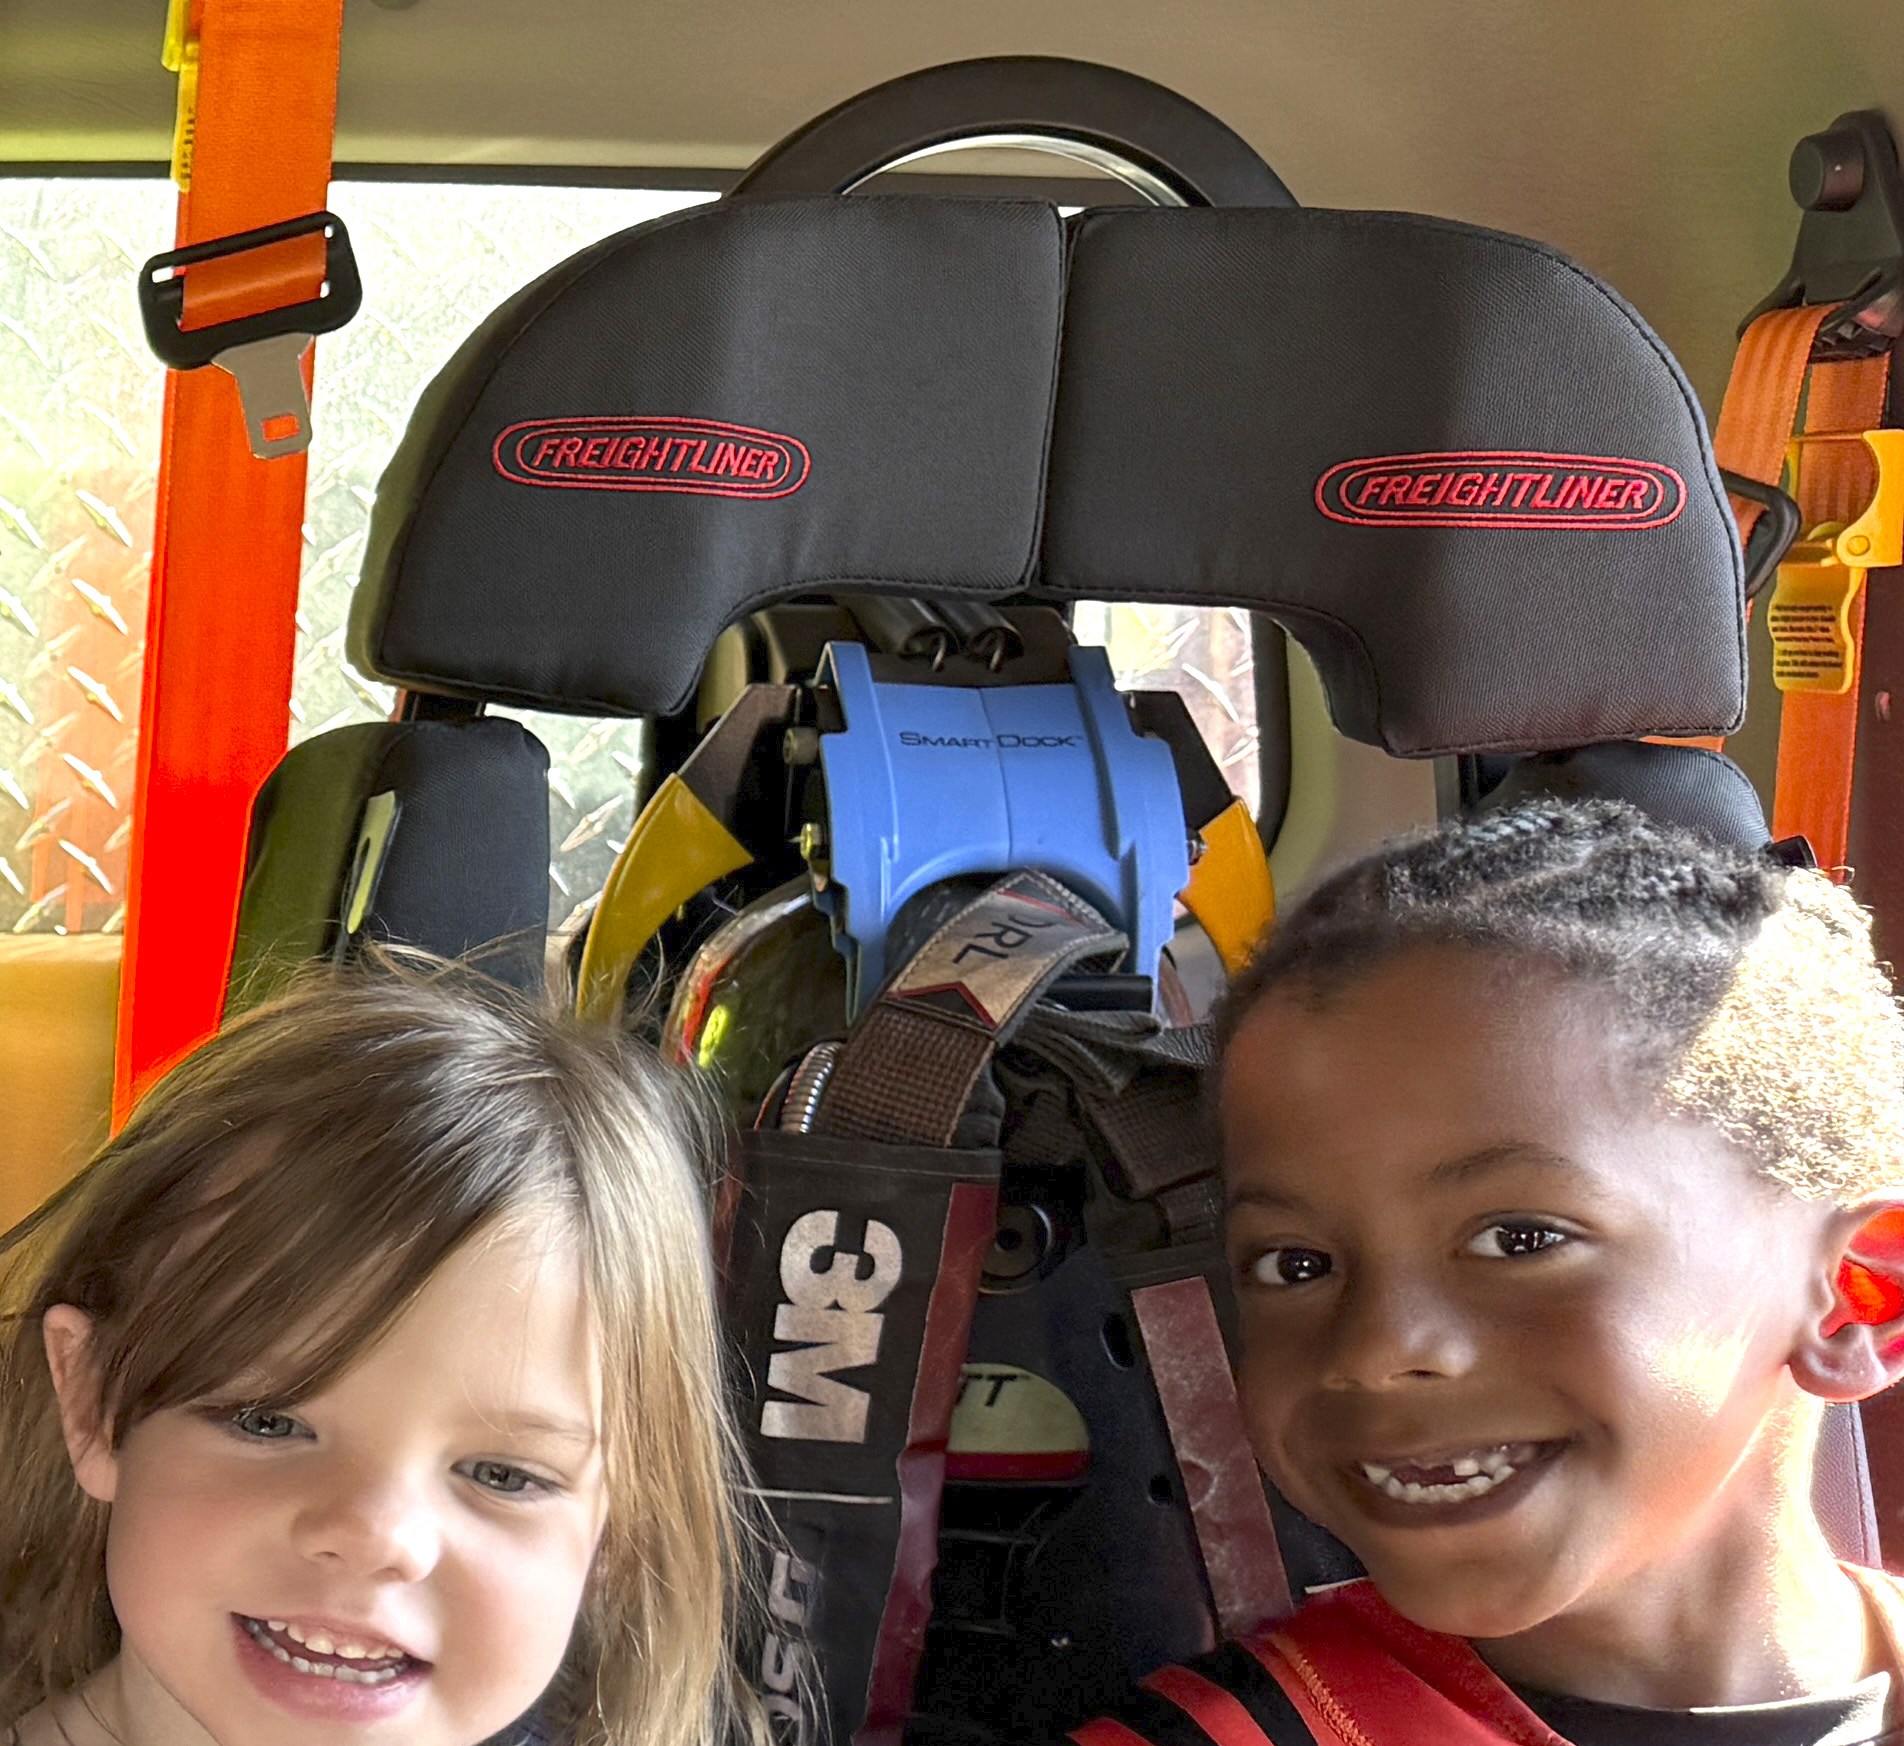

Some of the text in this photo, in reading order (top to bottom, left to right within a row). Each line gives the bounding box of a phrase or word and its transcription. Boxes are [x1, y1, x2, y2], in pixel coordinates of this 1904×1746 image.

[532, 435, 780, 481] FREIGHTLINER
[1356, 472, 1650, 511] FREIGHTLINER
[759, 1208, 904, 1445] 3M
